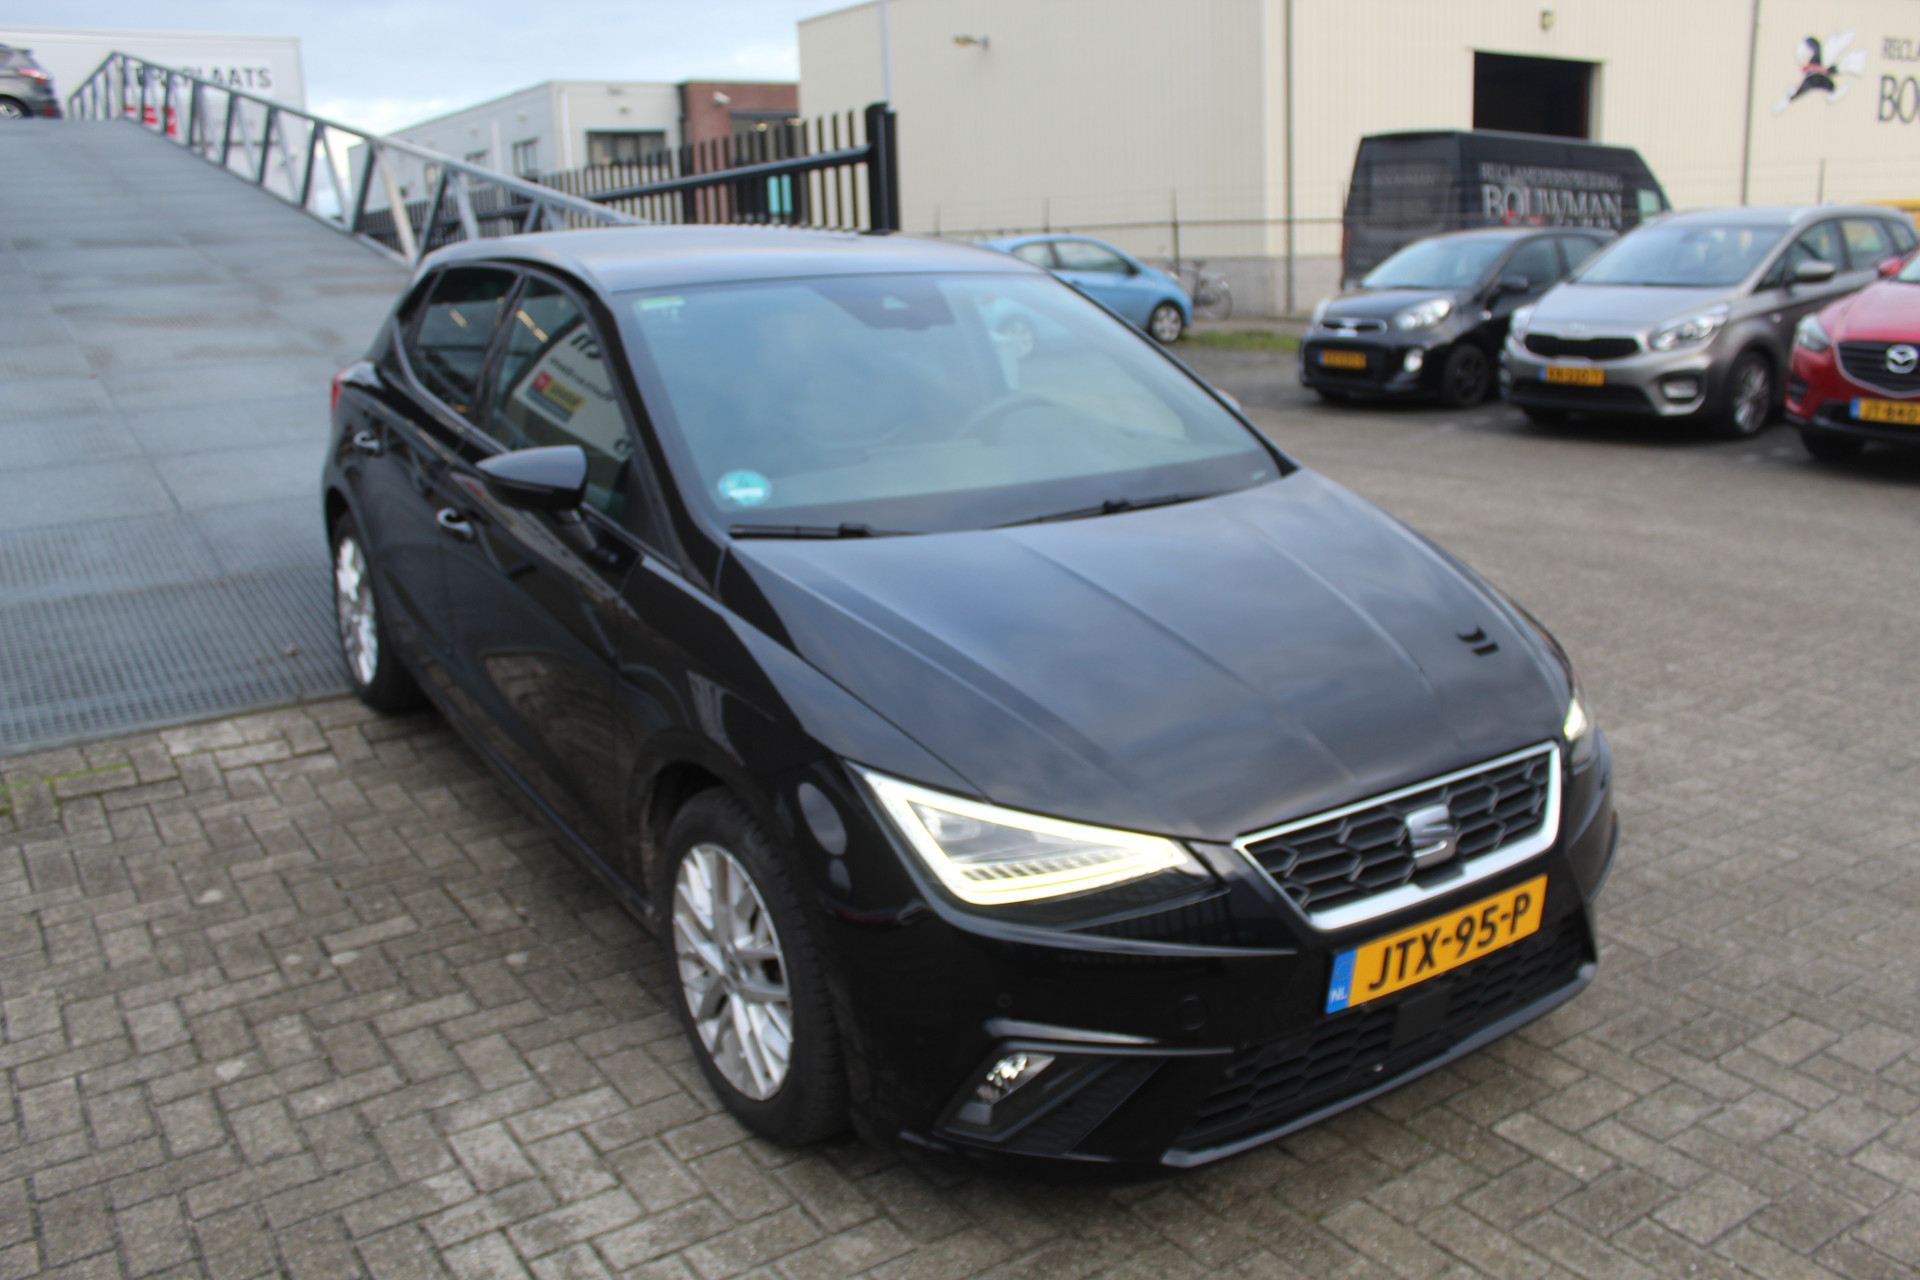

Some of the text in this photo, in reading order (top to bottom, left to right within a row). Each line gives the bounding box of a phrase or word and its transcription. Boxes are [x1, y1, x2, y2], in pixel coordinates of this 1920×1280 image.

[1882, 38, 1920, 62] RECL
[1879, 74, 1920, 123] BO
[1482, 183, 1623, 229] BOUWMAN
[1368, 892, 1531, 991] JTX-95-P
[1331, 986, 1348, 1001] NL
